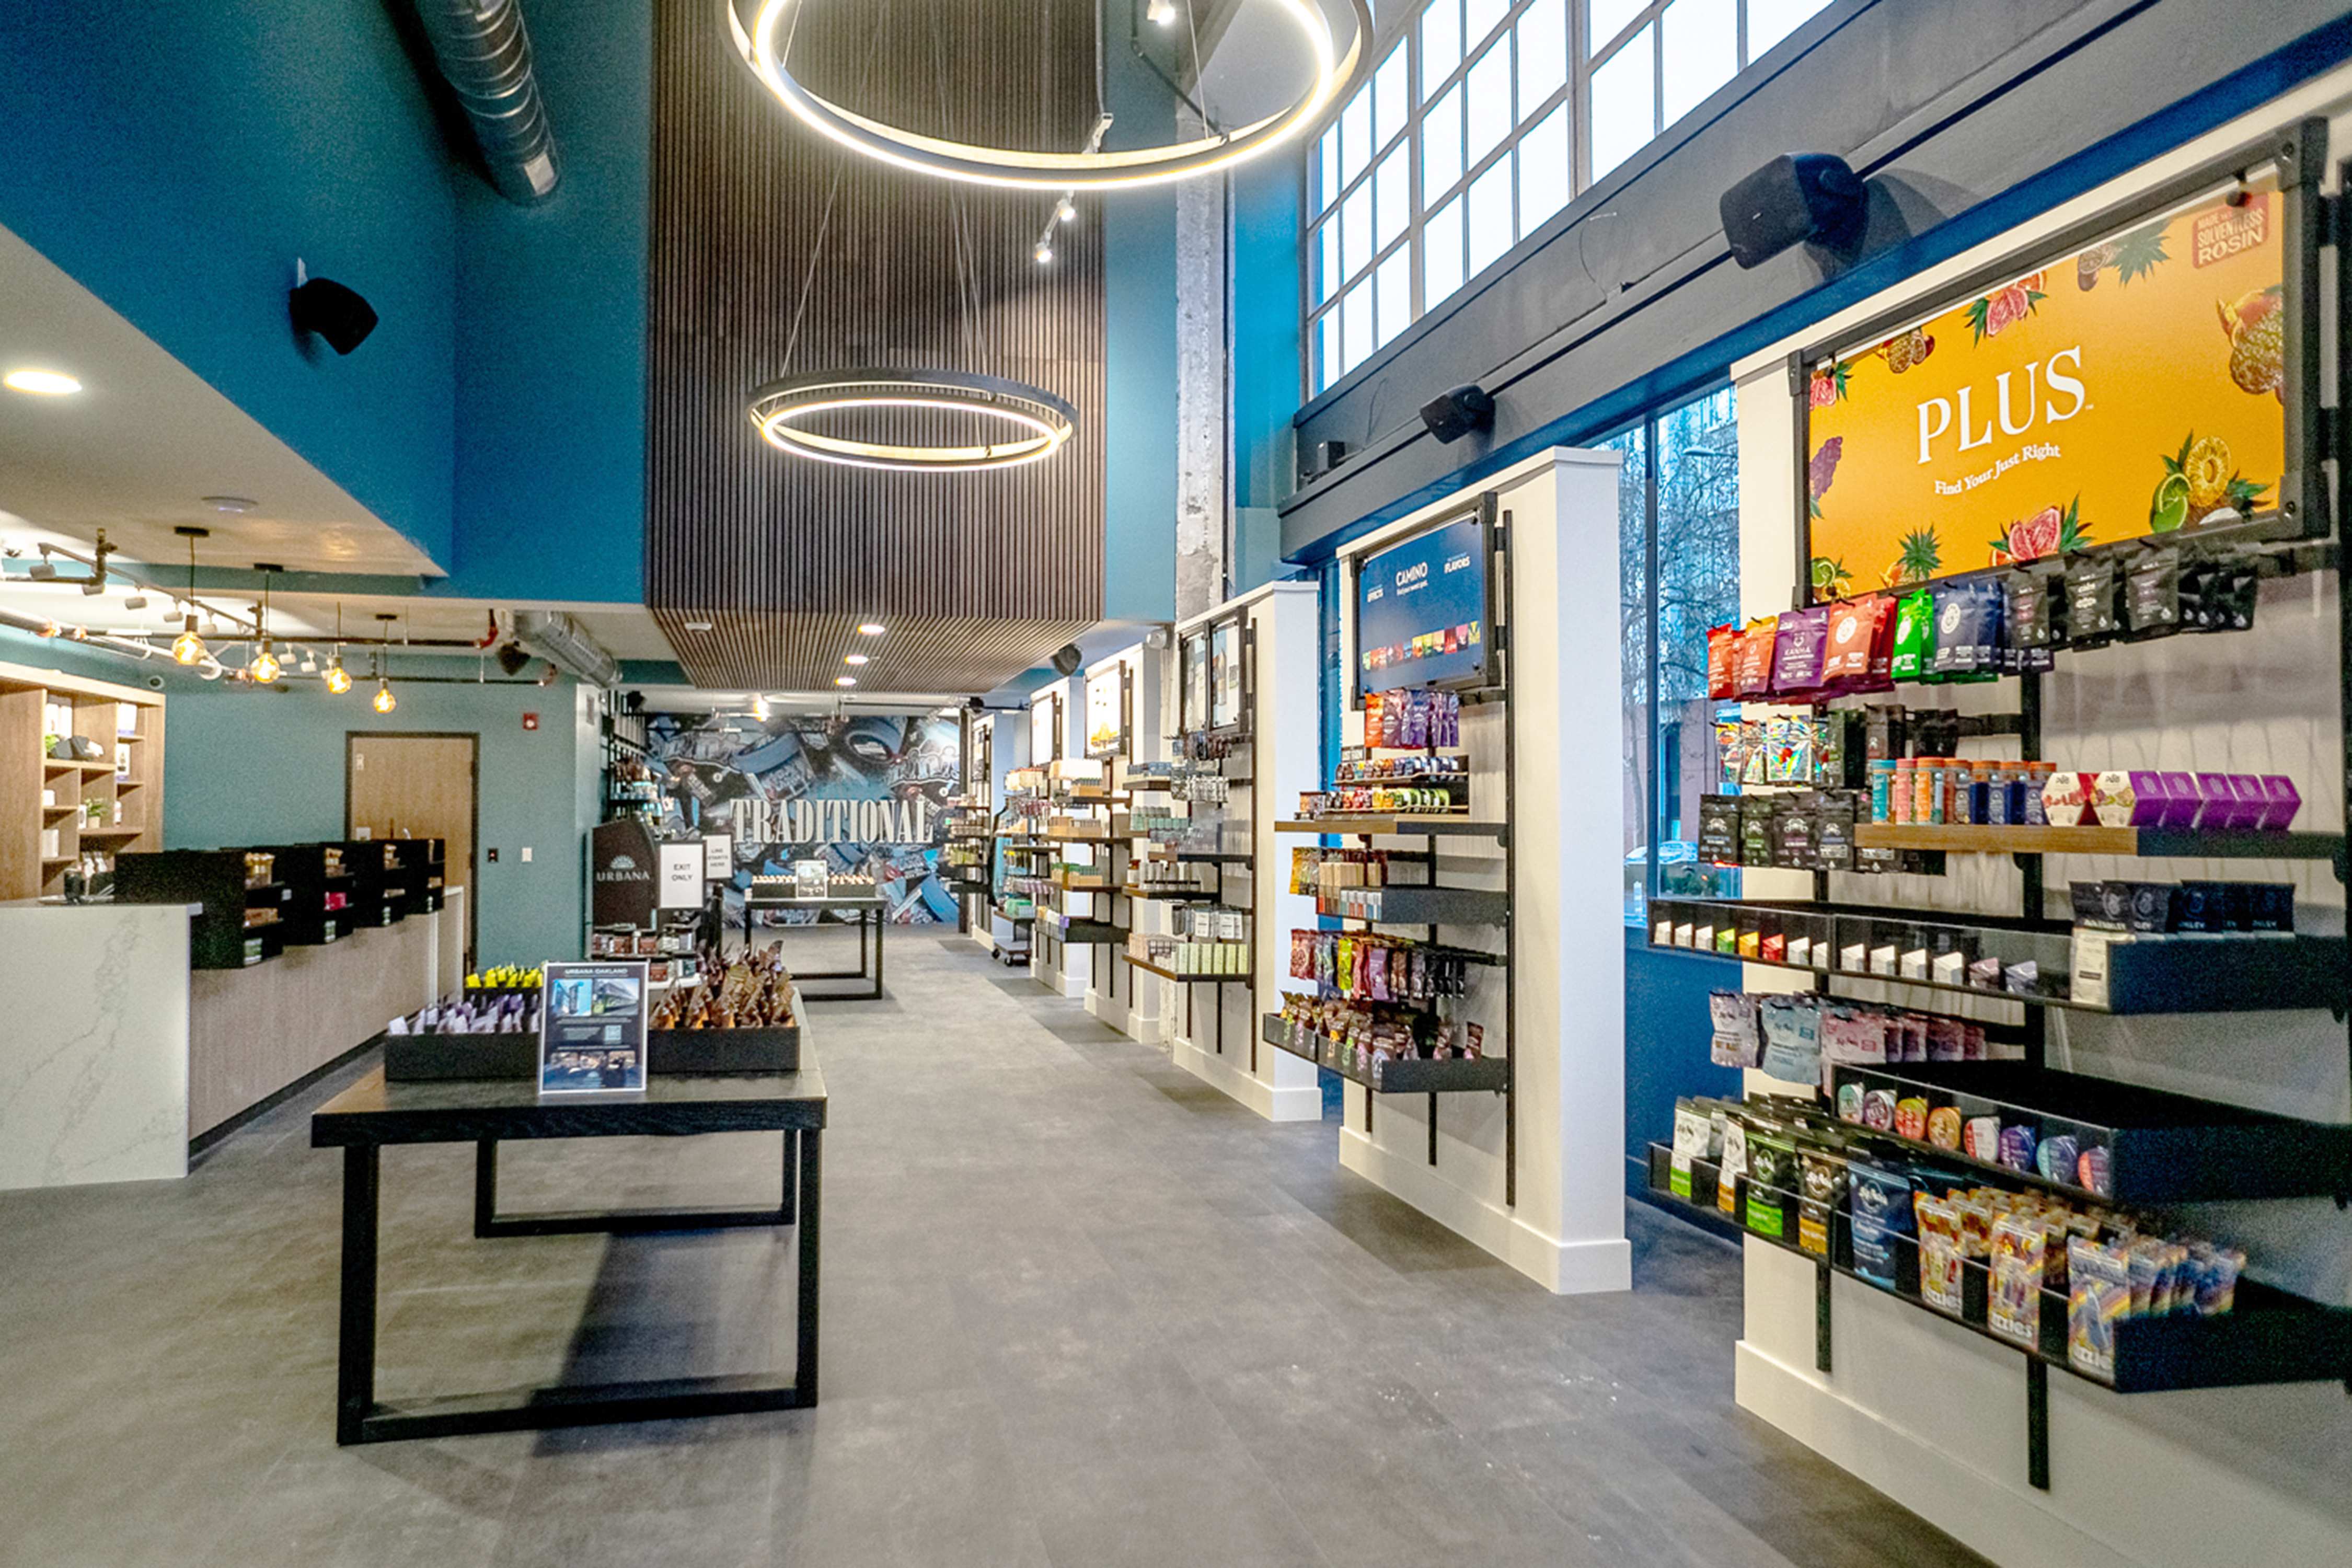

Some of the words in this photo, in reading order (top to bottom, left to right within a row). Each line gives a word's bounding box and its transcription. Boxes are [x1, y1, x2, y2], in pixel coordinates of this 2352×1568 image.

[2198, 207, 2264, 248] SOLVENTLESS
[2198, 226, 2262, 265] ROSIN
[1917, 345, 2085, 464] PLUS
[1934, 480, 1962, 495] Find
[1963, 468, 1993, 490] Your
[1993, 453, 2021, 480] Just
[2021, 442, 2061, 462] Right
[1396, 561, 1428, 587] CAMINO
[730, 798, 933, 844] TRADITIONAL
[596, 870, 650, 882] URBANA
